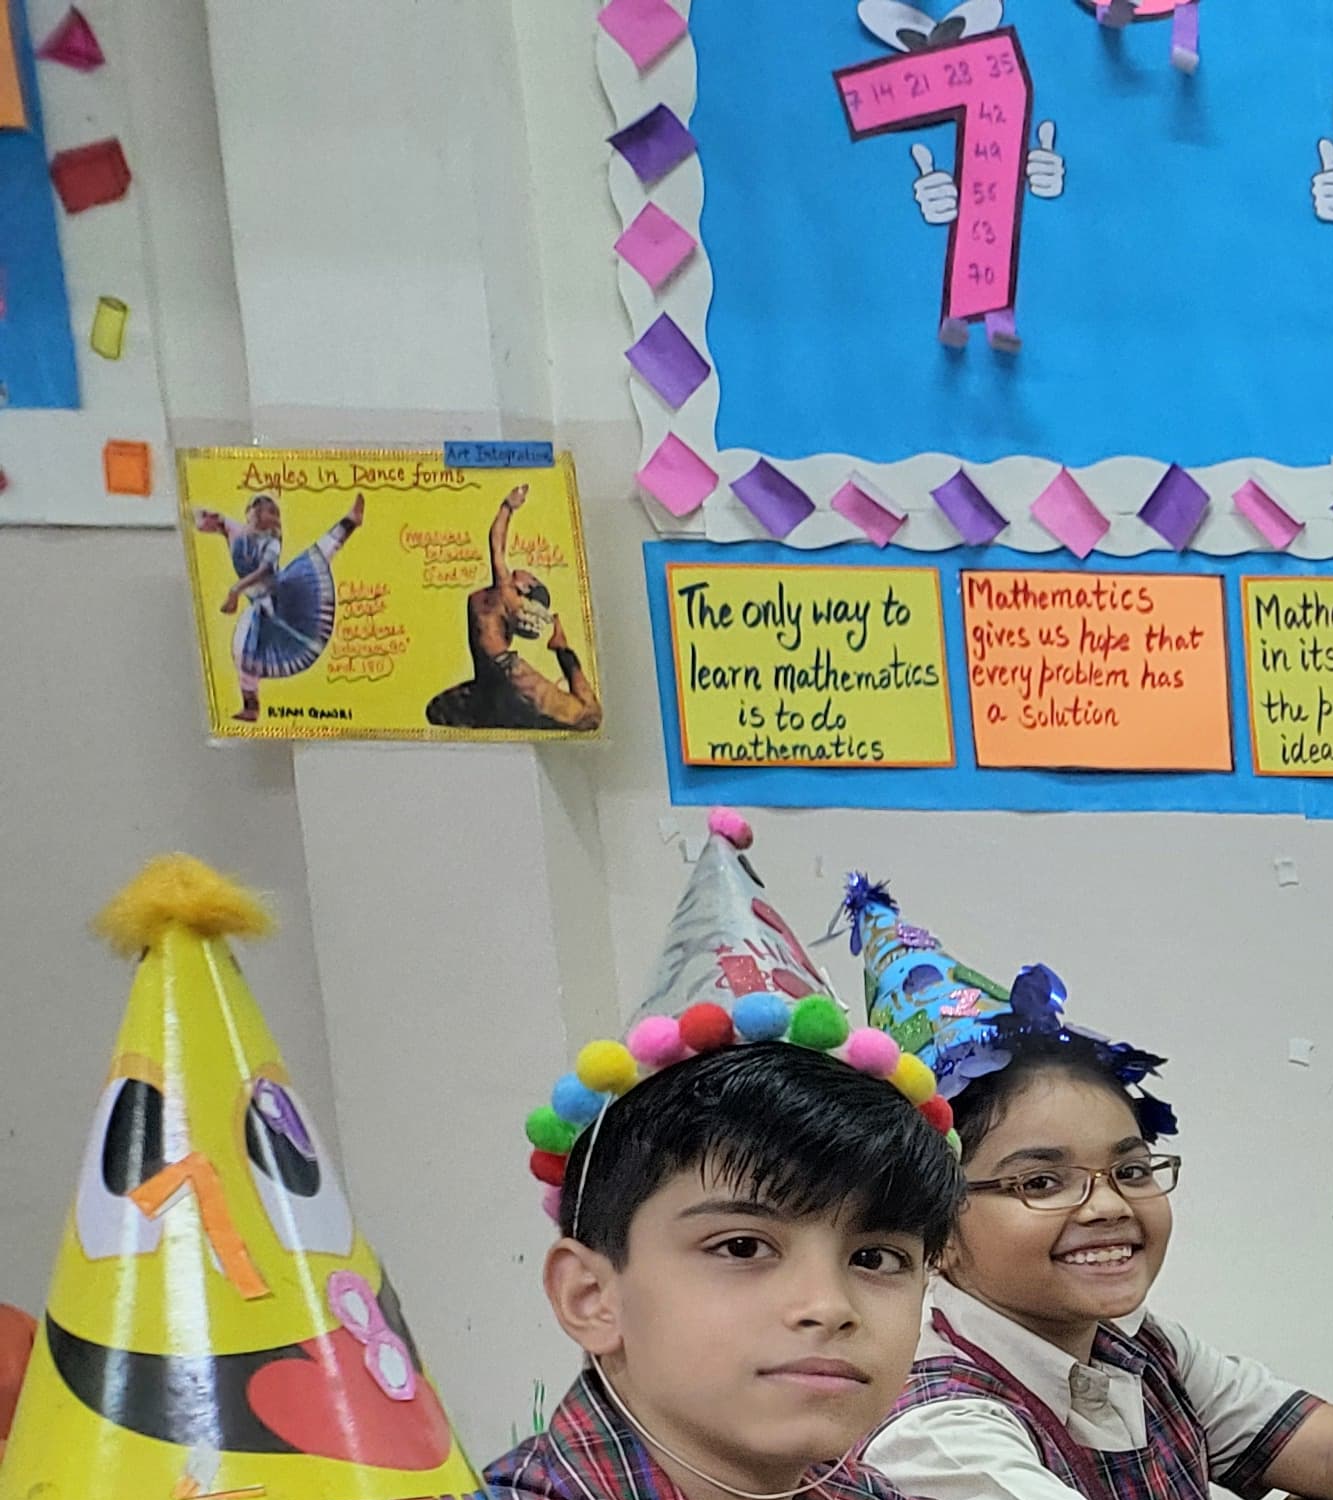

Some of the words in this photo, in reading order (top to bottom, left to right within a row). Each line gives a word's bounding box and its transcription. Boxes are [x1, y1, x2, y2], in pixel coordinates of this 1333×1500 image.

[871, 83, 893, 105] 14
[904, 72, 930, 98] 21
[243, 462, 308, 497] Angles
[350, 464, 406, 485] Dance
[412, 463, 466, 488] forms
[968, 574, 1156, 614] Mathematics
[678, 581, 733, 630] The
[742, 581, 803, 651] only
[811, 594, 871, 652] way
[880, 583, 913, 627] to
[971, 622, 1031, 662] gives
[1038, 625, 1071, 650] us
[1079, 618, 1131, 664] hope
[1144, 618, 1204, 654] that
[1260, 639, 1293, 674] in
[689, 645, 762, 693] learn
[774, 646, 941, 694] mathematics
[971, 664, 1033, 700] every
[1037, 657, 1130, 700] problem
[1140, 656, 1186, 690] has
[738, 702, 766, 730] is
[775, 700, 808, 729] to
[810, 698, 848, 731] do
[986, 705, 1009, 724] a
[1018, 697, 1121, 730] solution
[1261, 690, 1310, 725] the
[708, 733, 886, 762] mathematics
